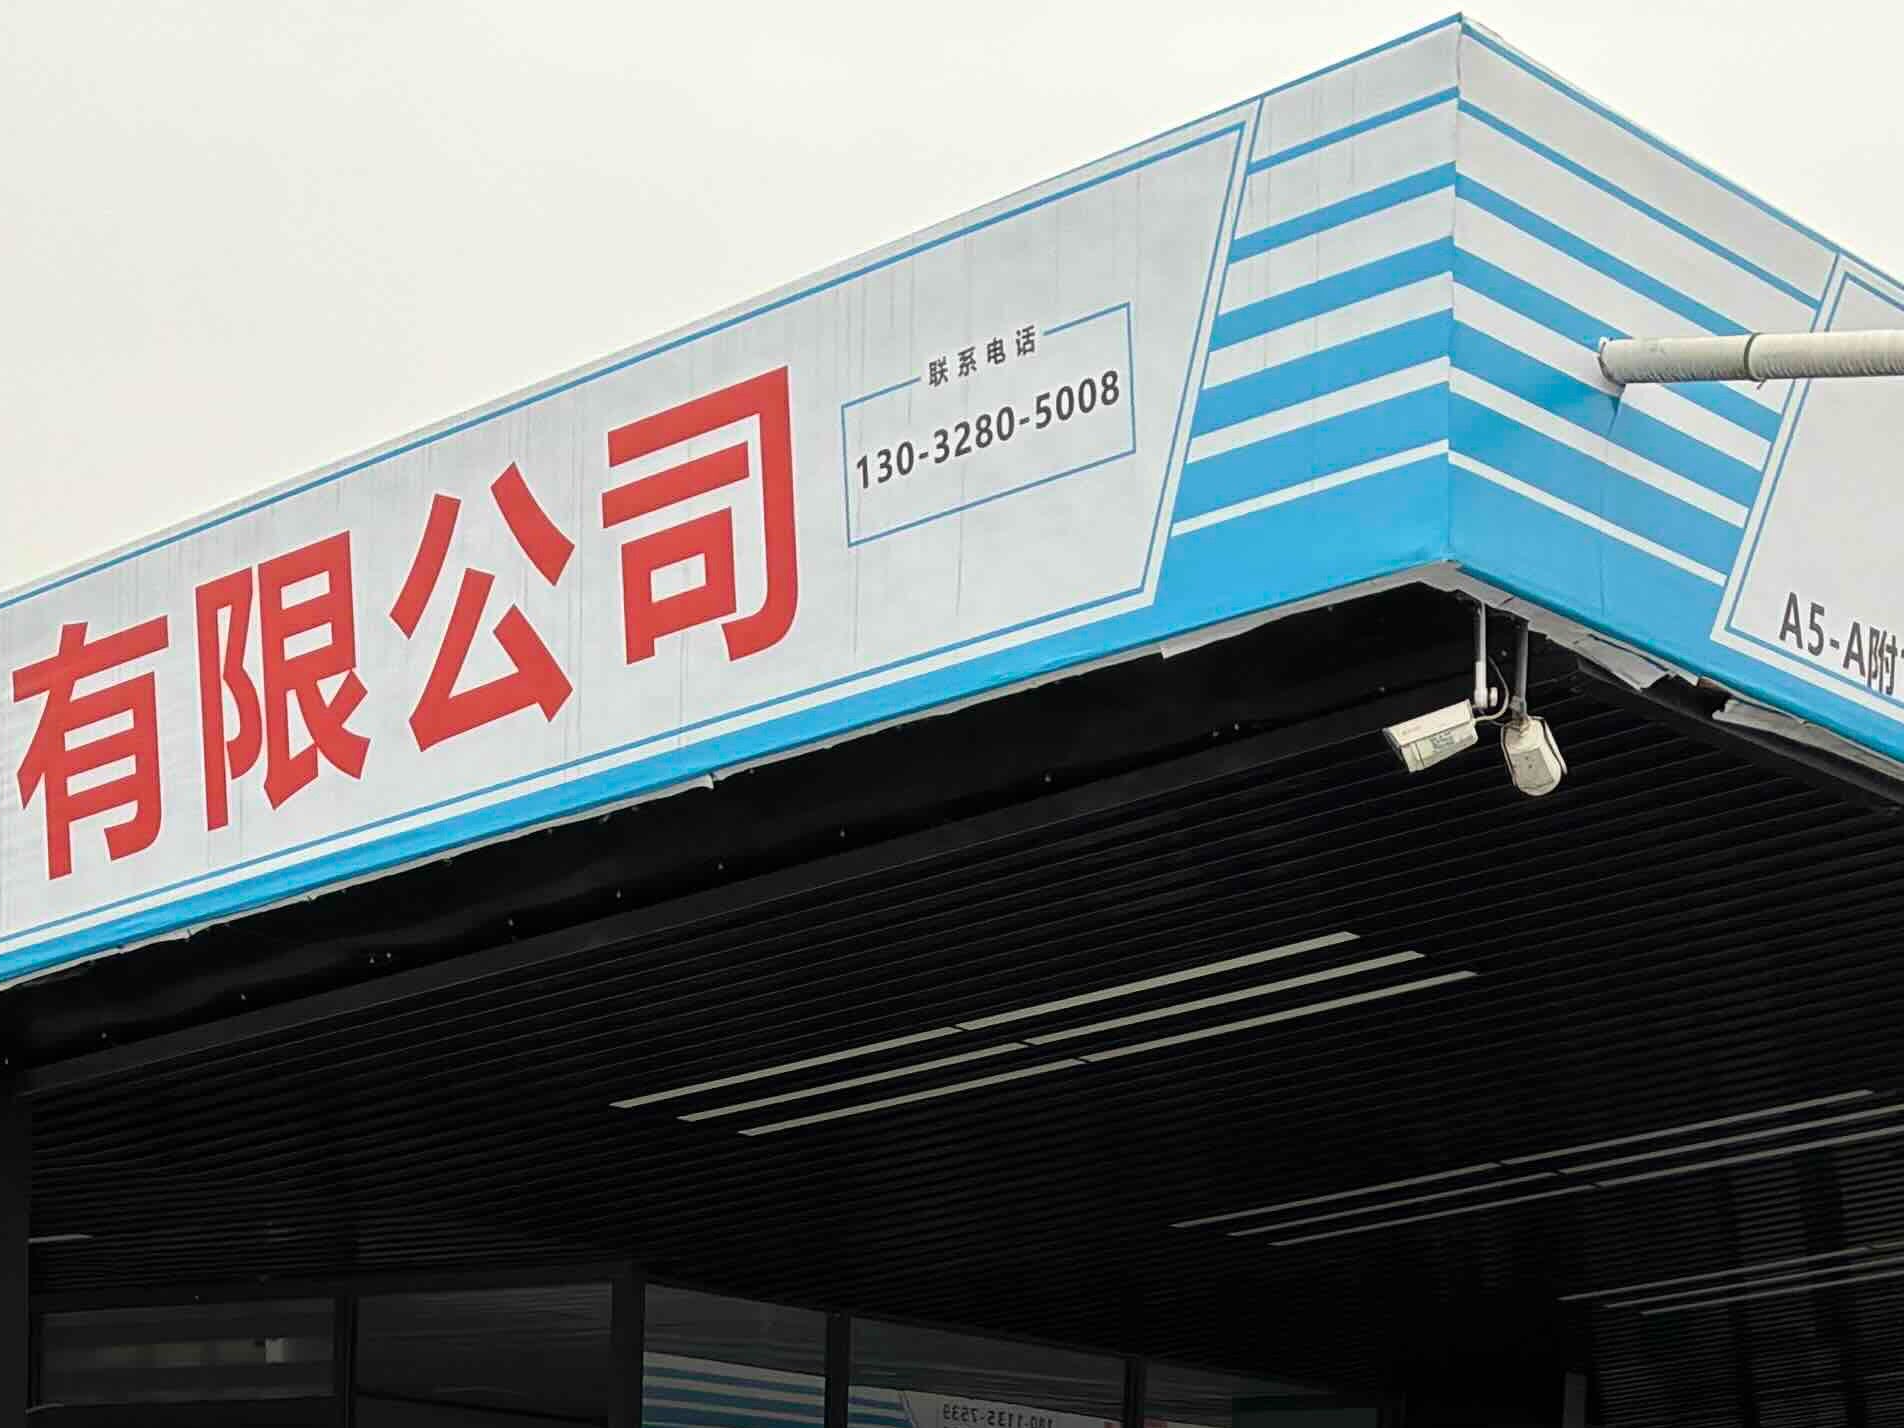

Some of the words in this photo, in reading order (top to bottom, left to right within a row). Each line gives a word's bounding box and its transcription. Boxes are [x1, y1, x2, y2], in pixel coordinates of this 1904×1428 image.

[928, 325, 1036, 387] 联系电话
[856, 370, 1120, 489] 130-3280-5008
